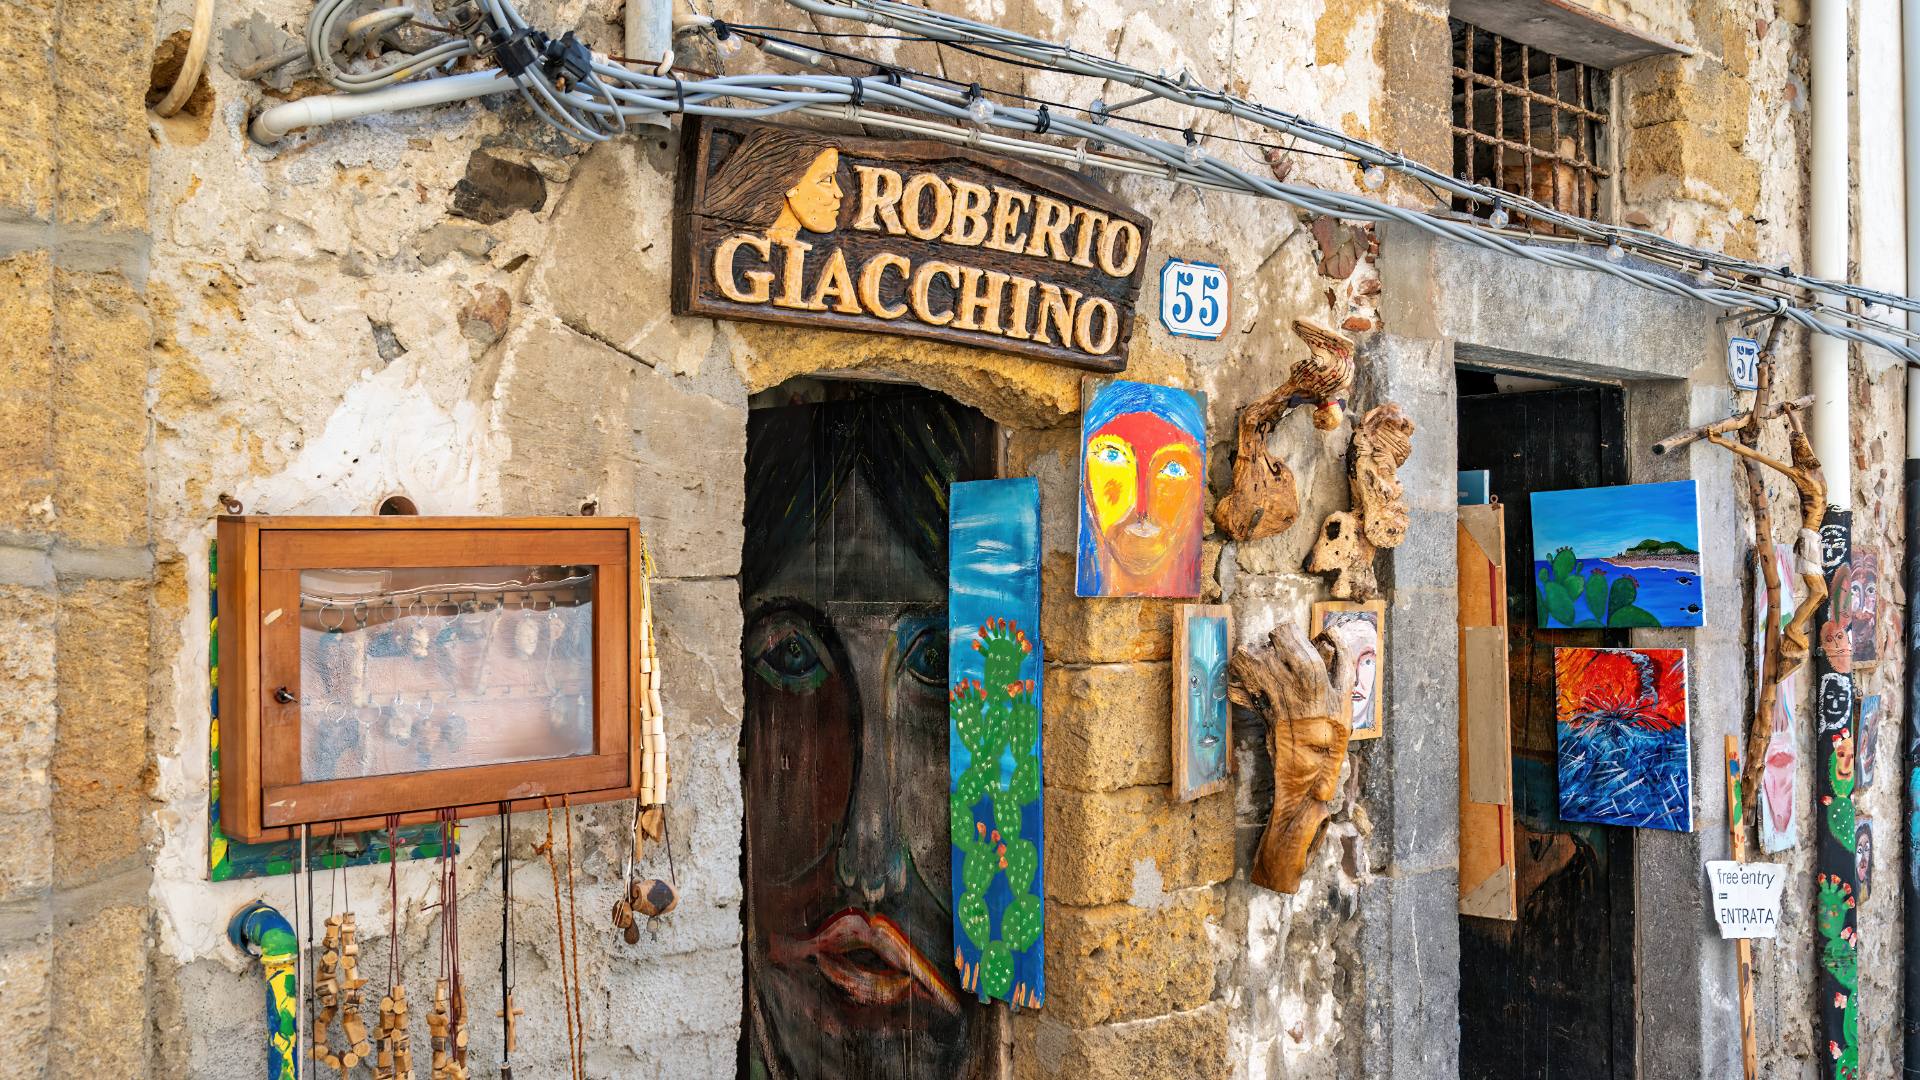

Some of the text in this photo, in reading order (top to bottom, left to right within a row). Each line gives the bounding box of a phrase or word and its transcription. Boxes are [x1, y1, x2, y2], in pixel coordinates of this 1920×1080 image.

[854, 165, 1143, 278] ROBERTO
[713, 234, 1119, 355] GIACCHINO
[1172, 271, 1221, 328] 55
[1736, 345, 1755, 382] 57
[1717, 868, 1776, 889] free entry
[1721, 908, 1775, 924] ENTRATA
